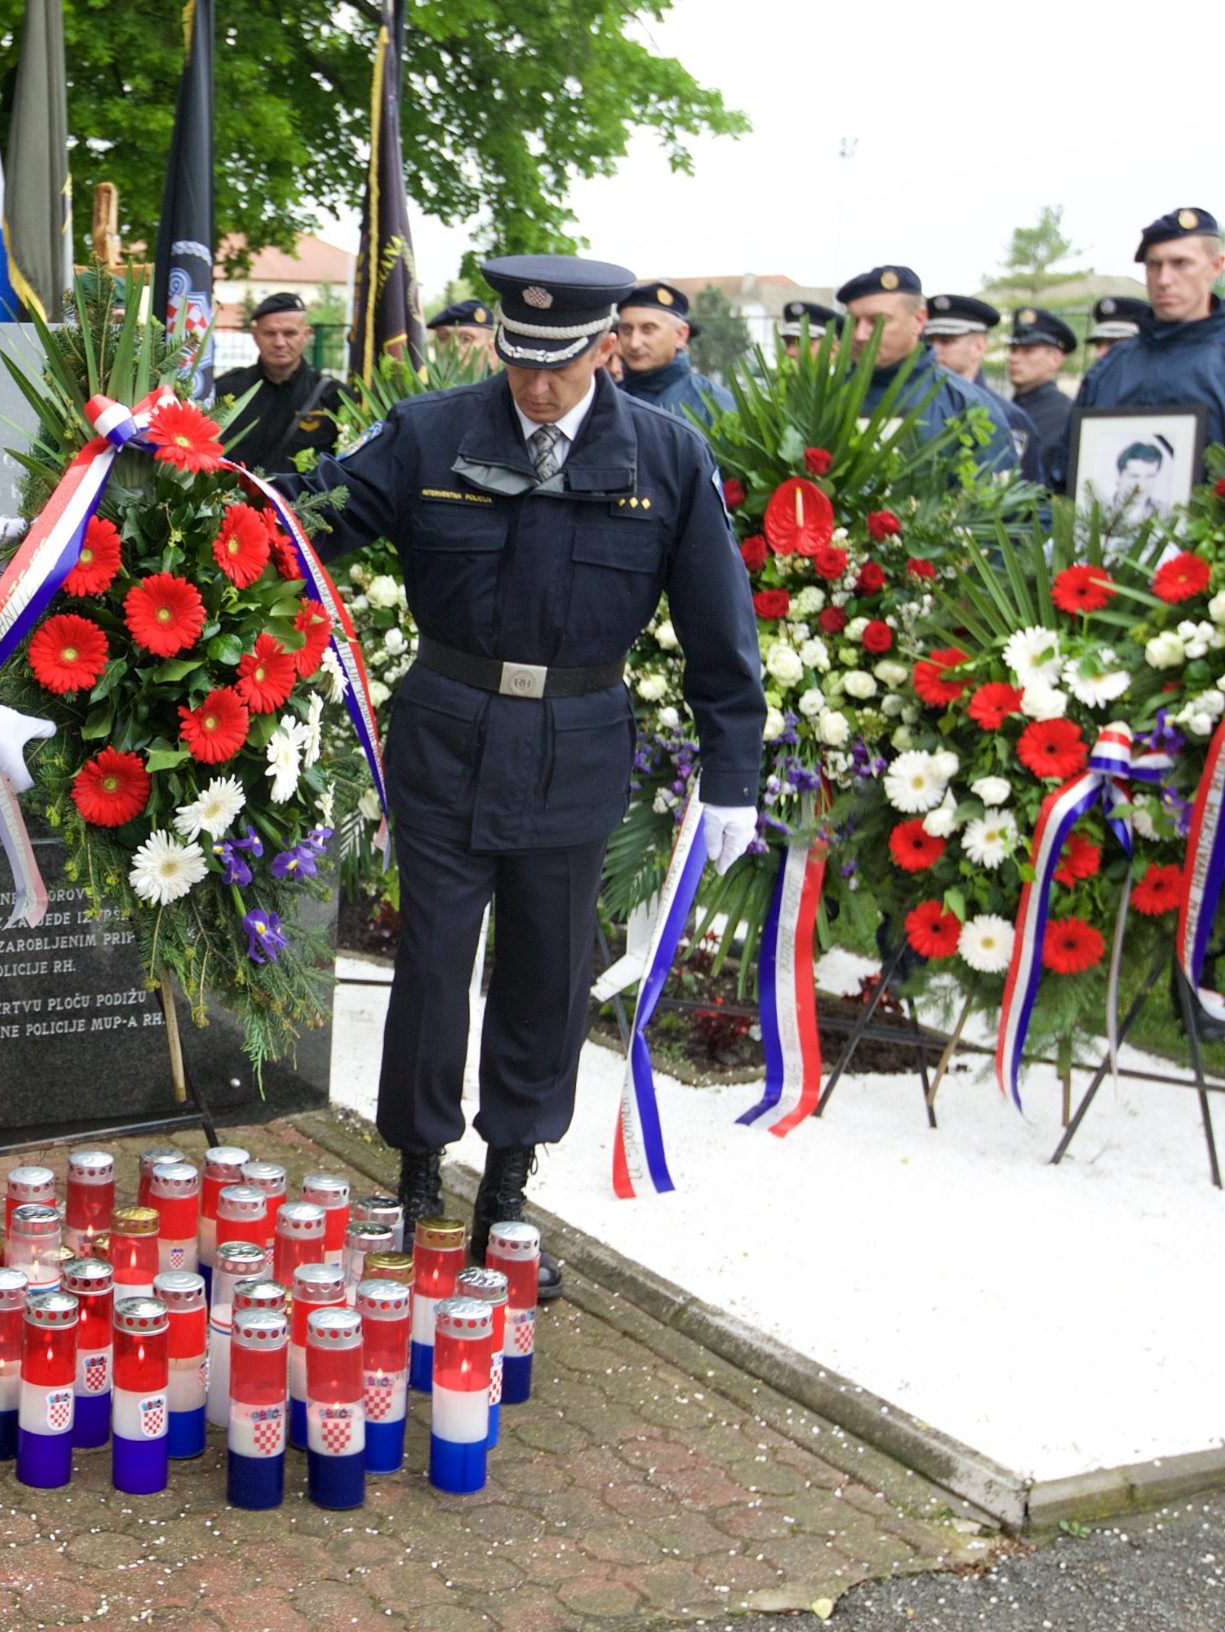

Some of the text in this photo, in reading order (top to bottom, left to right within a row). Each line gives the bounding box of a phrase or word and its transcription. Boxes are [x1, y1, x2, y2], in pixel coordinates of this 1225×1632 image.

[47, 993, 90, 1011] PLOČU
[96, 988, 147, 1007] PODIŽU
[26, 1018, 85, 1036] POLICIJE
[91, 1015, 138, 1031] MUP-A
